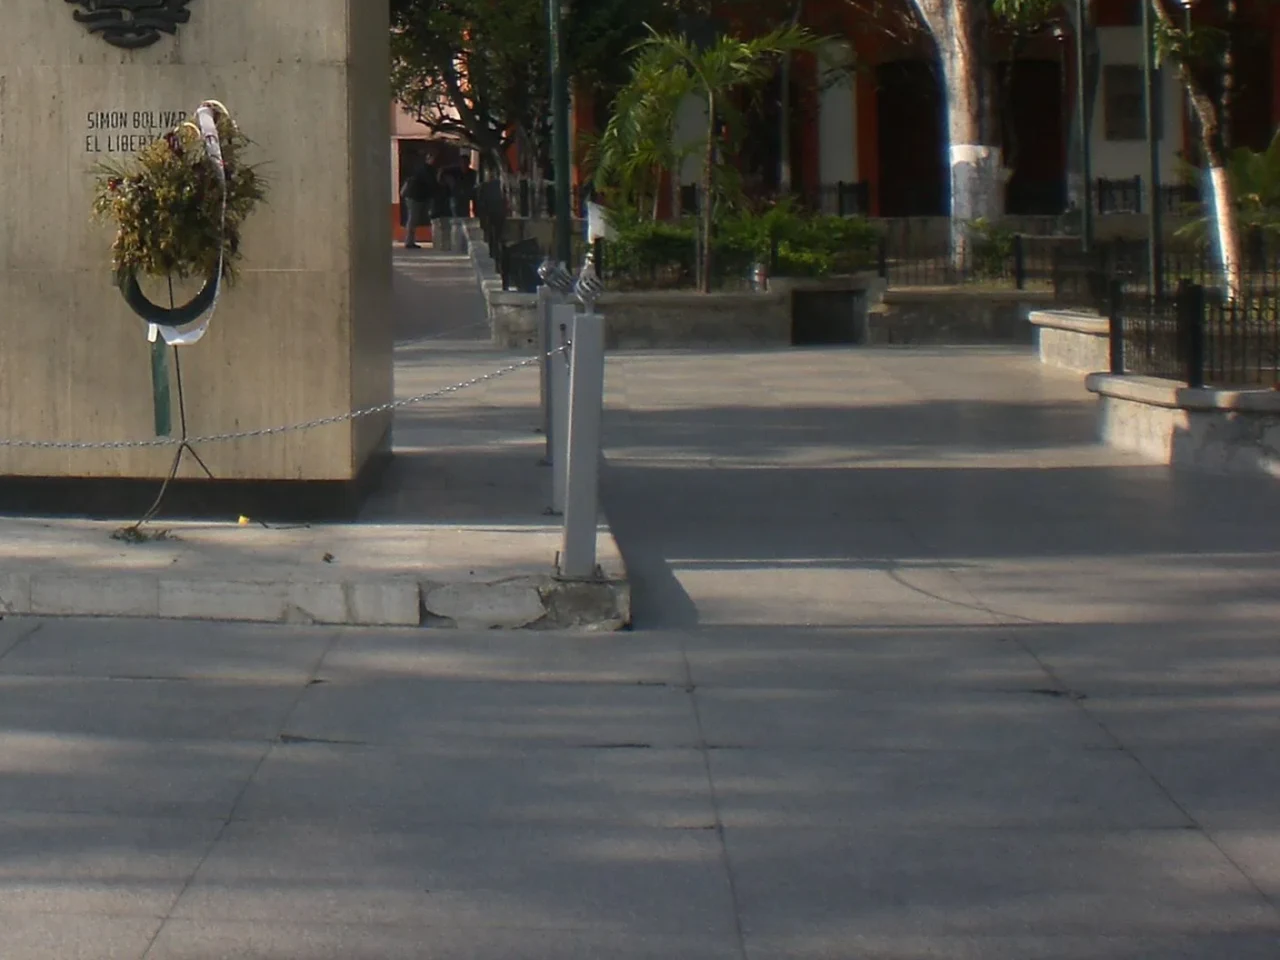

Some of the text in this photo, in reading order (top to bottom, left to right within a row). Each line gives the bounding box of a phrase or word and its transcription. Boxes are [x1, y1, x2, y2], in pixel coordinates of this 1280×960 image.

[87, 111, 187, 129] SIMON BOLIVAR
[86, 135, 102, 152] EL
